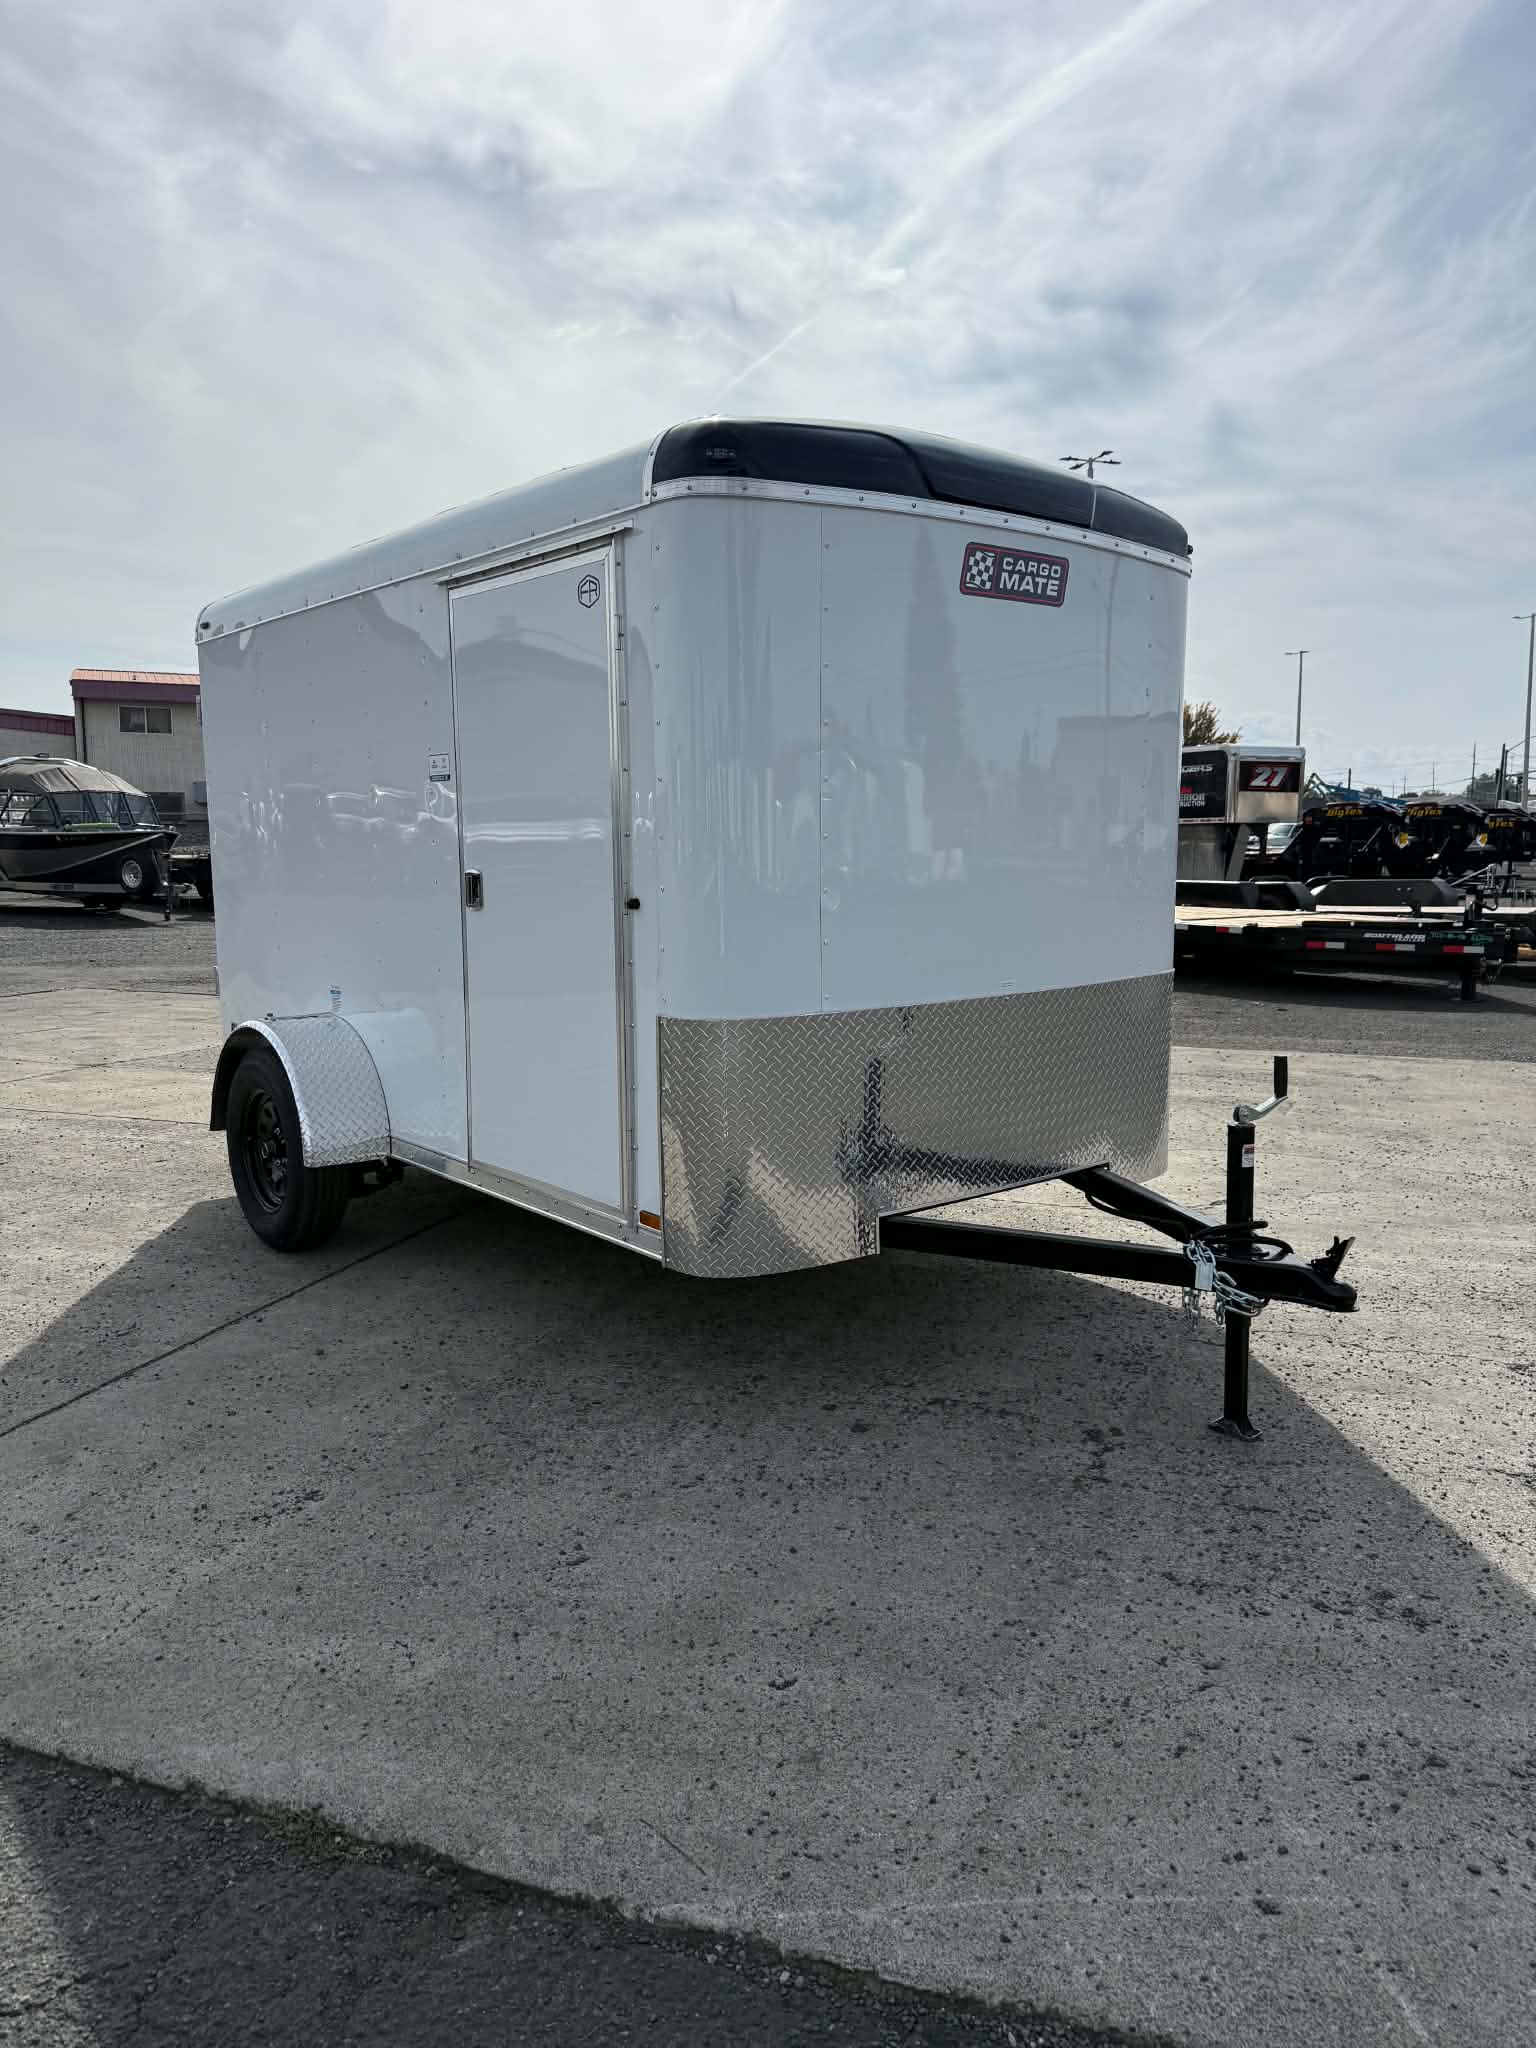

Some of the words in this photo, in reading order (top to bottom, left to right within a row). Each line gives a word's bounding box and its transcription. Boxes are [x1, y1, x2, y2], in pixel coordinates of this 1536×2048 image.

[1002, 557, 1061, 578] CARGO
[999, 572, 1060, 597] MATE
[1249, 766, 1289, 787] 27
